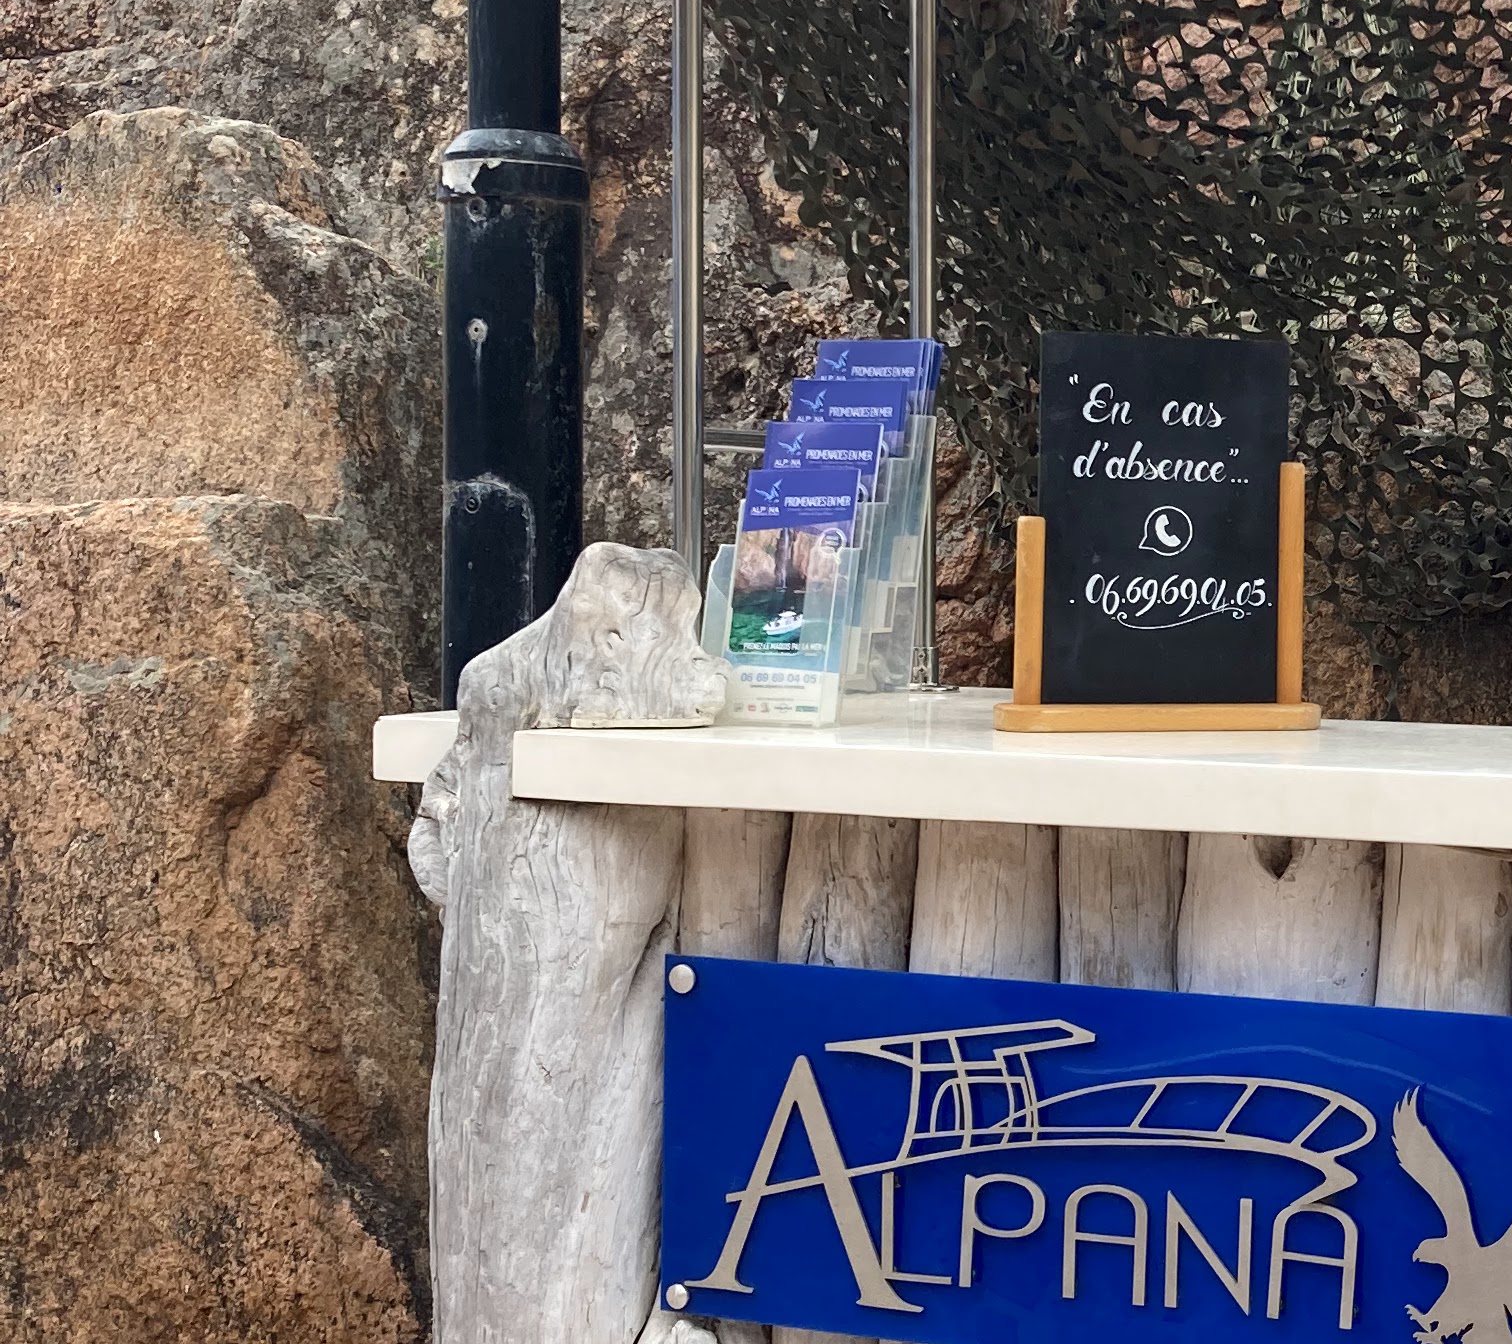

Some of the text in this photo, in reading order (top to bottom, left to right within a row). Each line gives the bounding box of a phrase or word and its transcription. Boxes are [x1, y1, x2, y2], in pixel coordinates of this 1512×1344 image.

[1161, 400, 1227, 428] cas
[797, 415, 825, 423] ALPNA
[773, 459, 802, 467] ALPNA
[751, 506, 780, 514] ALPNA
[683, 1055, 1358, 1330] ALPANA
